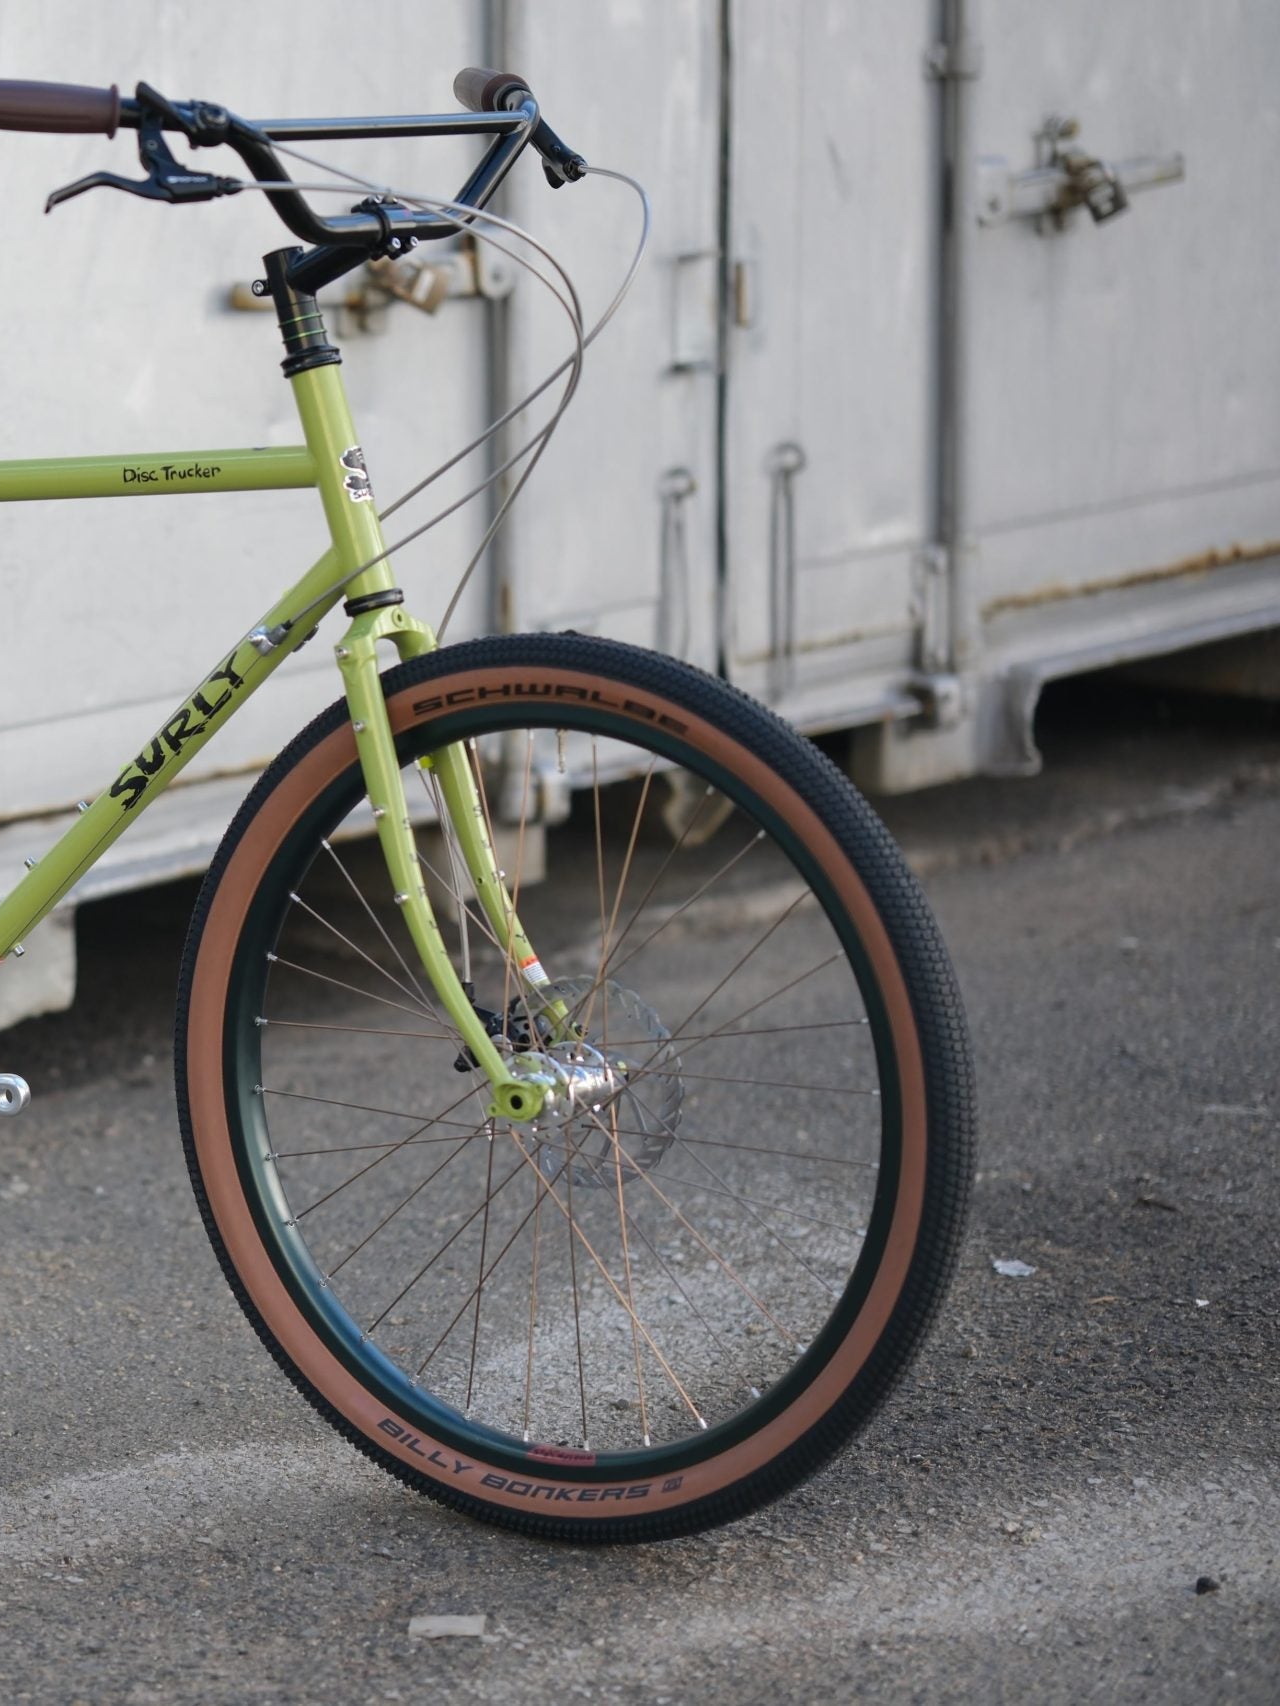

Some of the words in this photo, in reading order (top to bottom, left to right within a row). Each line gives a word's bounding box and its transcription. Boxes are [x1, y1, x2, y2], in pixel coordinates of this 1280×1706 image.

[123, 466, 158, 483] Disc
[160, 463, 221, 480] Trucker
[109, 651, 244, 811] SURLY
[412, 683, 689, 735] SCHWALBE
[377, 1418, 473, 1475] BILLY
[480, 1473, 652, 1502] BONKERS
